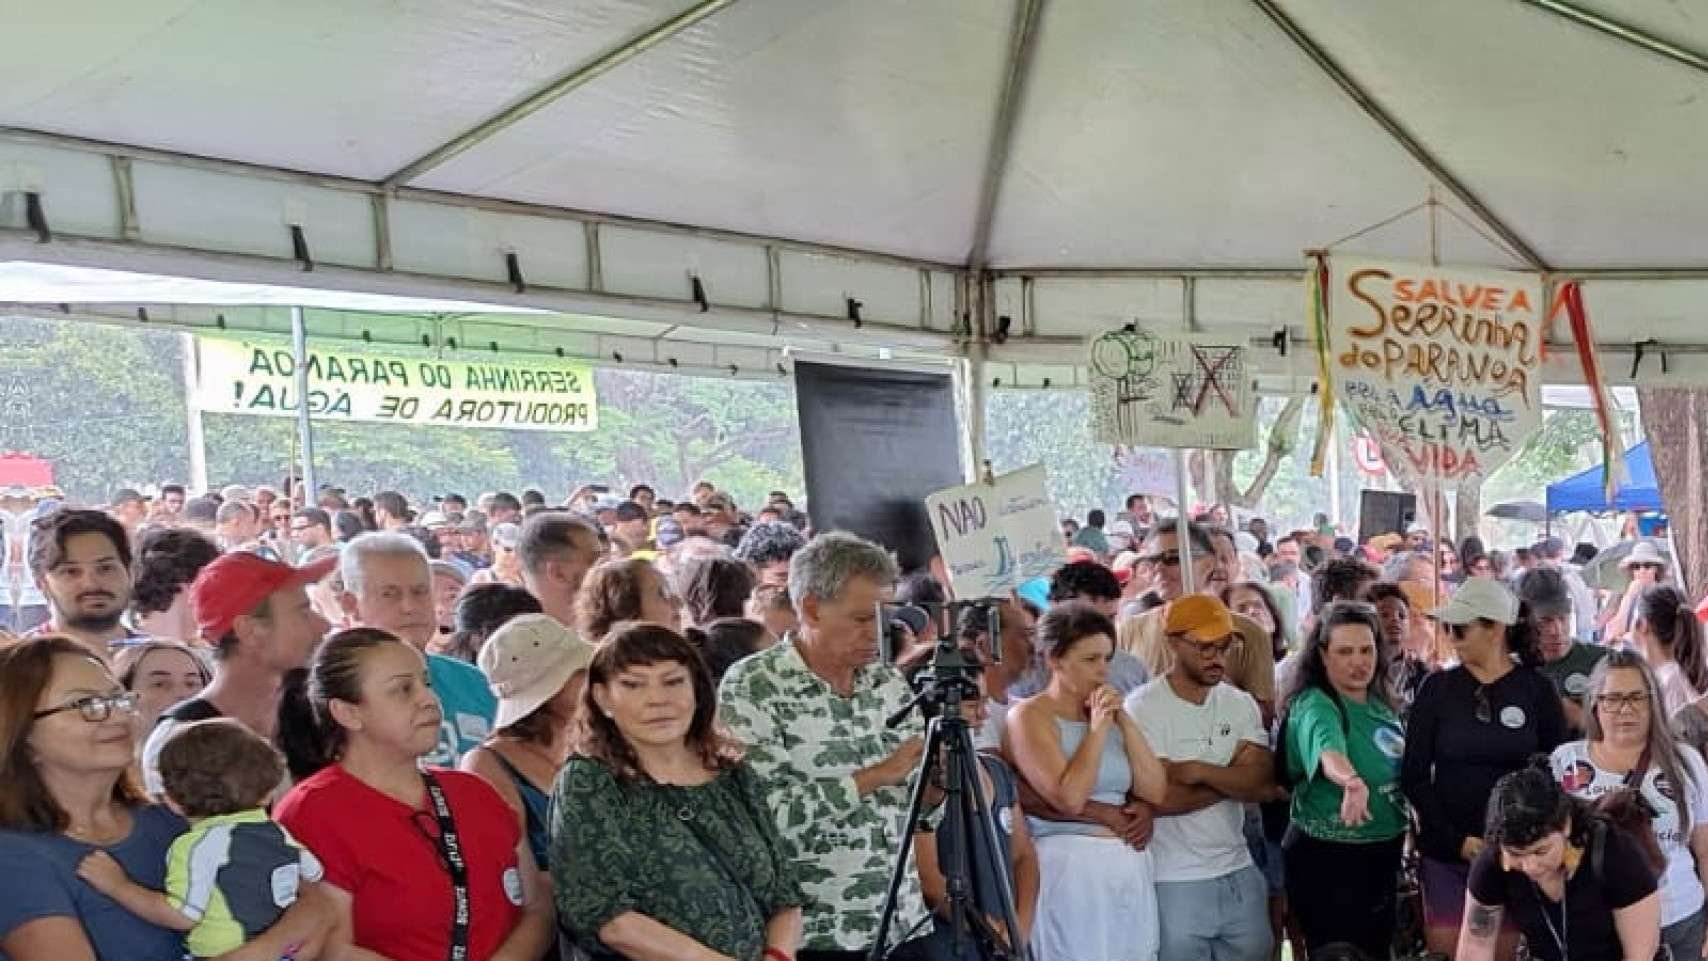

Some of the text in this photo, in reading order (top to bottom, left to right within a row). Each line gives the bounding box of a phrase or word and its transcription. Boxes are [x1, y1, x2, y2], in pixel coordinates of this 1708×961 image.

[1393, 278, 1532, 313] SALVE A
[1404, 442, 1483, 478] VIDA
